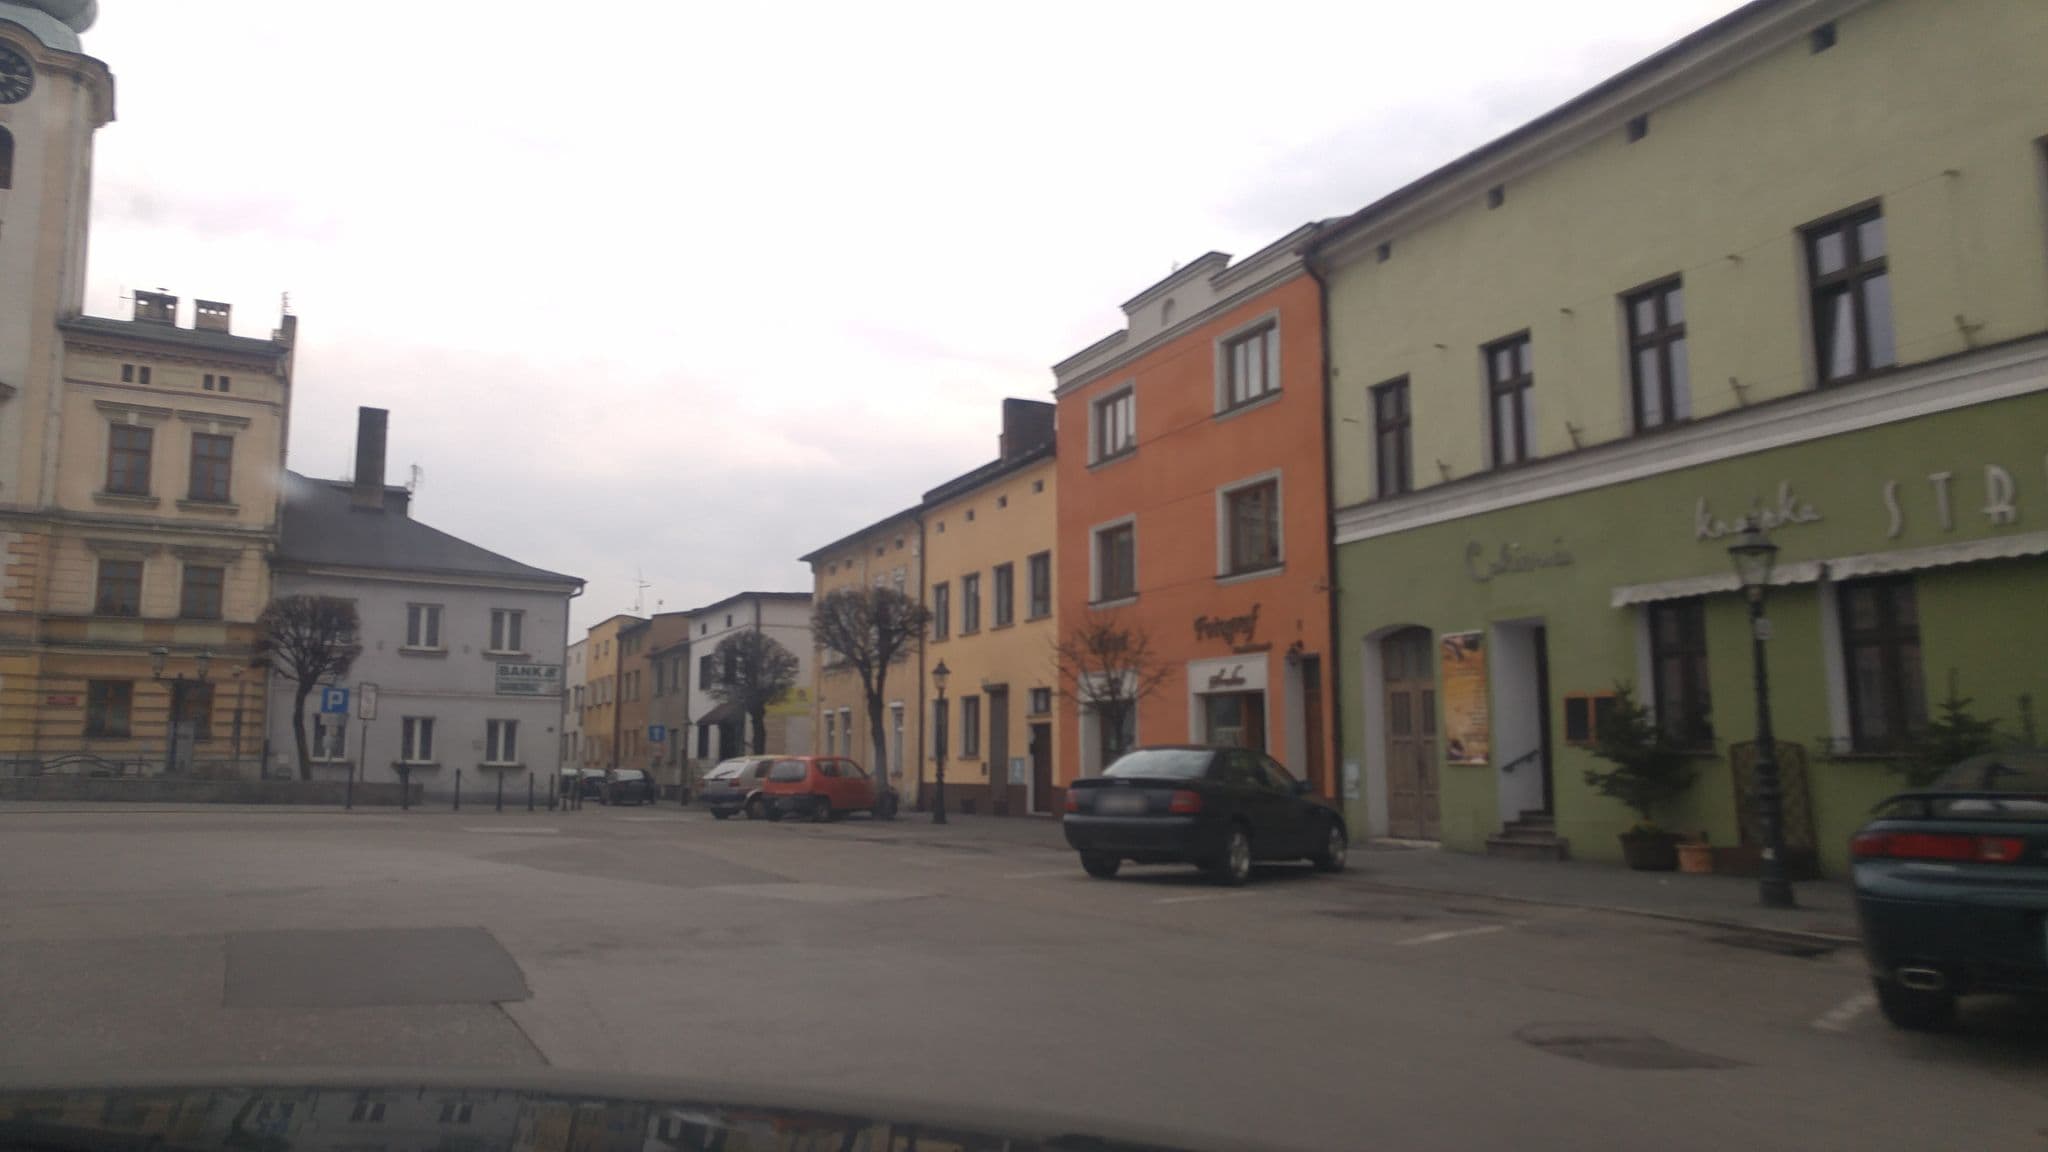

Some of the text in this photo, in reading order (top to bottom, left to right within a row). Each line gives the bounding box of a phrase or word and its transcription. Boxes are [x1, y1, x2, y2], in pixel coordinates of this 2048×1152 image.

[1880, 452, 2048, 540] STR
[499, 665, 542, 677] BANK
[327, 690, 345, 711] P
